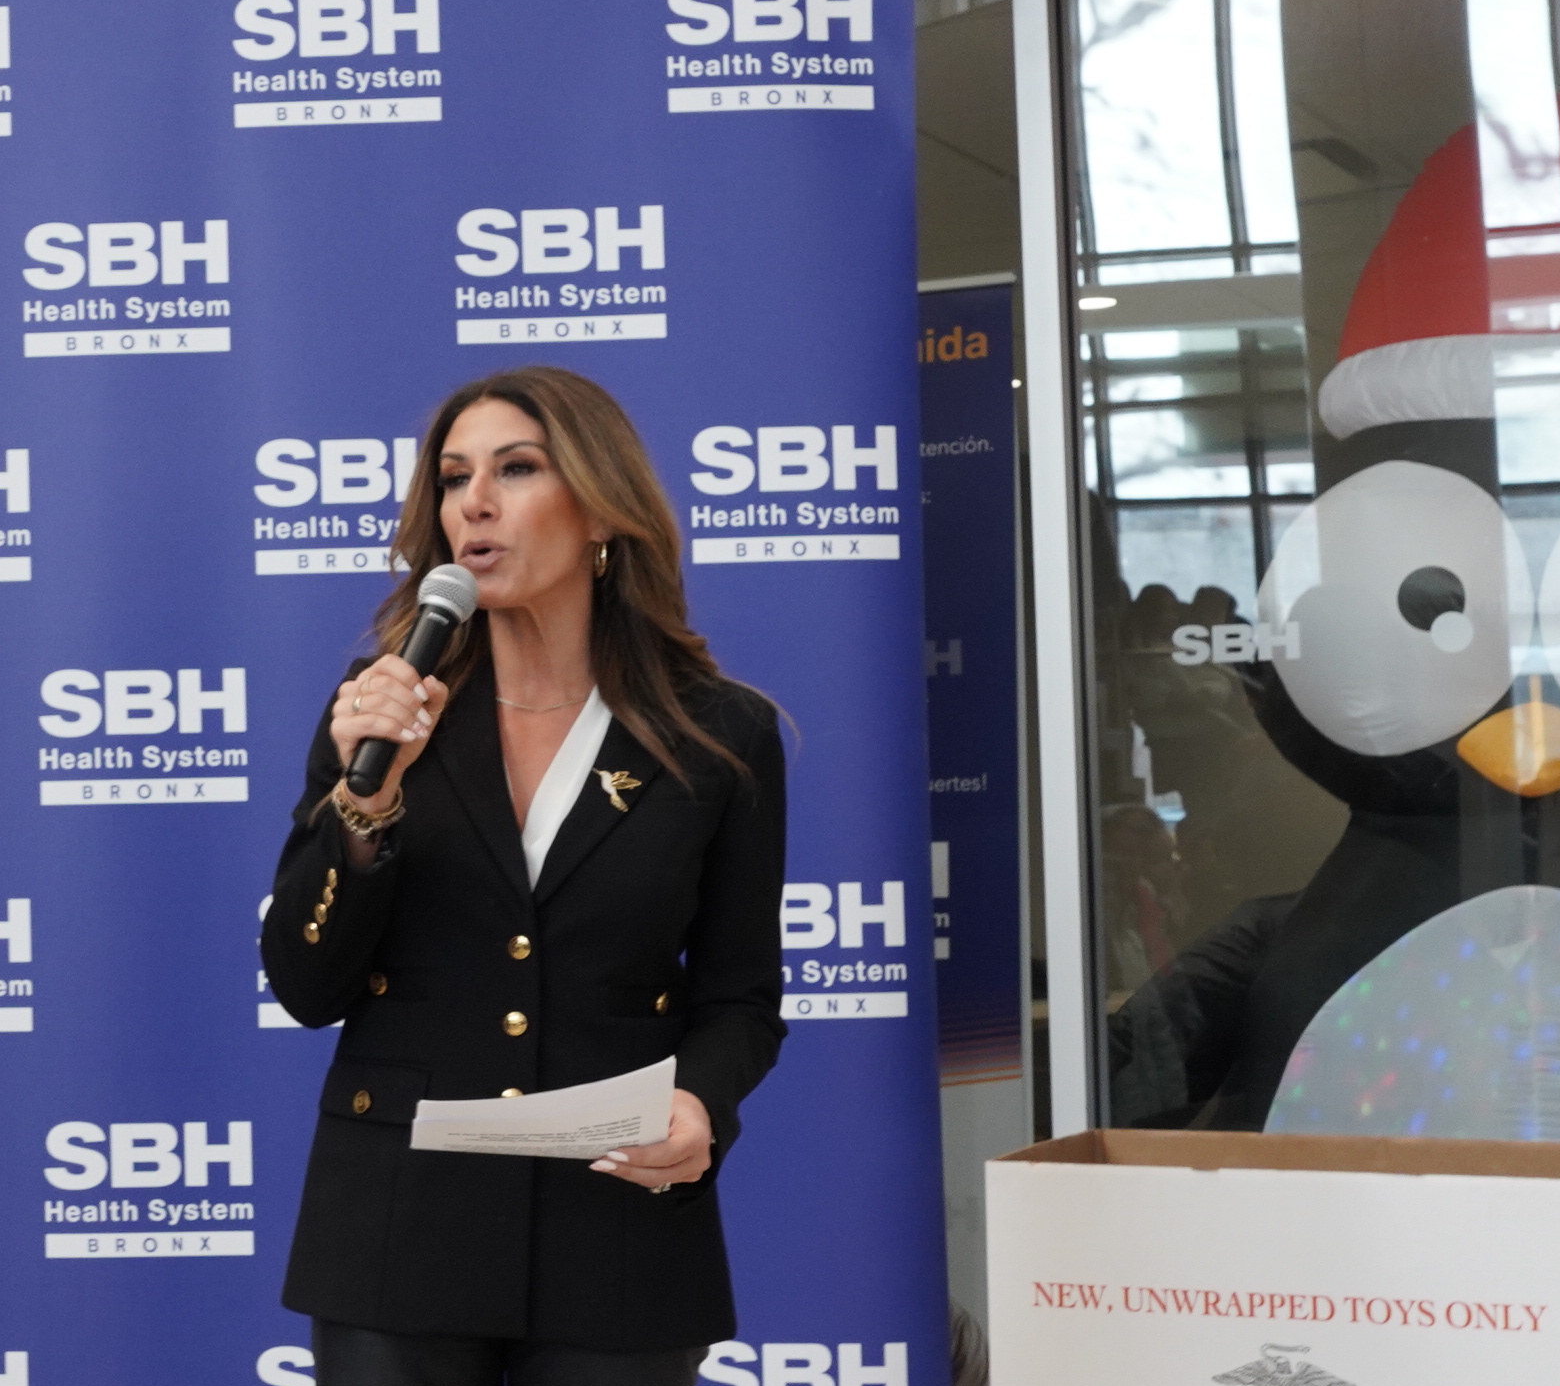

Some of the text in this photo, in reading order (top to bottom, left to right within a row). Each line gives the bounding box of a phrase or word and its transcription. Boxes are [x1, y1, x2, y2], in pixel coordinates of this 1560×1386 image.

[667, 52, 873, 78] Health System
[233, 67, 441, 93] Health System
[710, 89, 833, 107] BRONX
[276, 104, 398, 121] BRONX
[455, 205, 665, 276] SBH
[23, 220, 229, 290] SBH
[23, 297, 230, 322] Health System
[456, 284, 666, 310] Health System
[65, 334, 187, 351] BRONX
[498, 320, 623, 339] BRONX
[691, 426, 897, 495] SBH
[254, 515, 349, 540] Health
[691, 502, 898, 529] Health System
[734, 539, 860, 558] BRONX
[1172, 621, 1302, 666] SBH
[39, 668, 247, 738] SBH
[40, 746, 247, 772] Health System
[81, 783, 205, 800] BRONX
[780, 881, 906, 950] BH
[802, 959, 908, 988] System
[797, 998, 866, 1015] ONX
[44, 1122, 252, 1190] SBH
[45, 1199, 253, 1225] Health System
[86, 1236, 211, 1254] BRONX
[1032, 1281, 1548, 1334] NEW, UNWRAPPED TOYS ONLY
